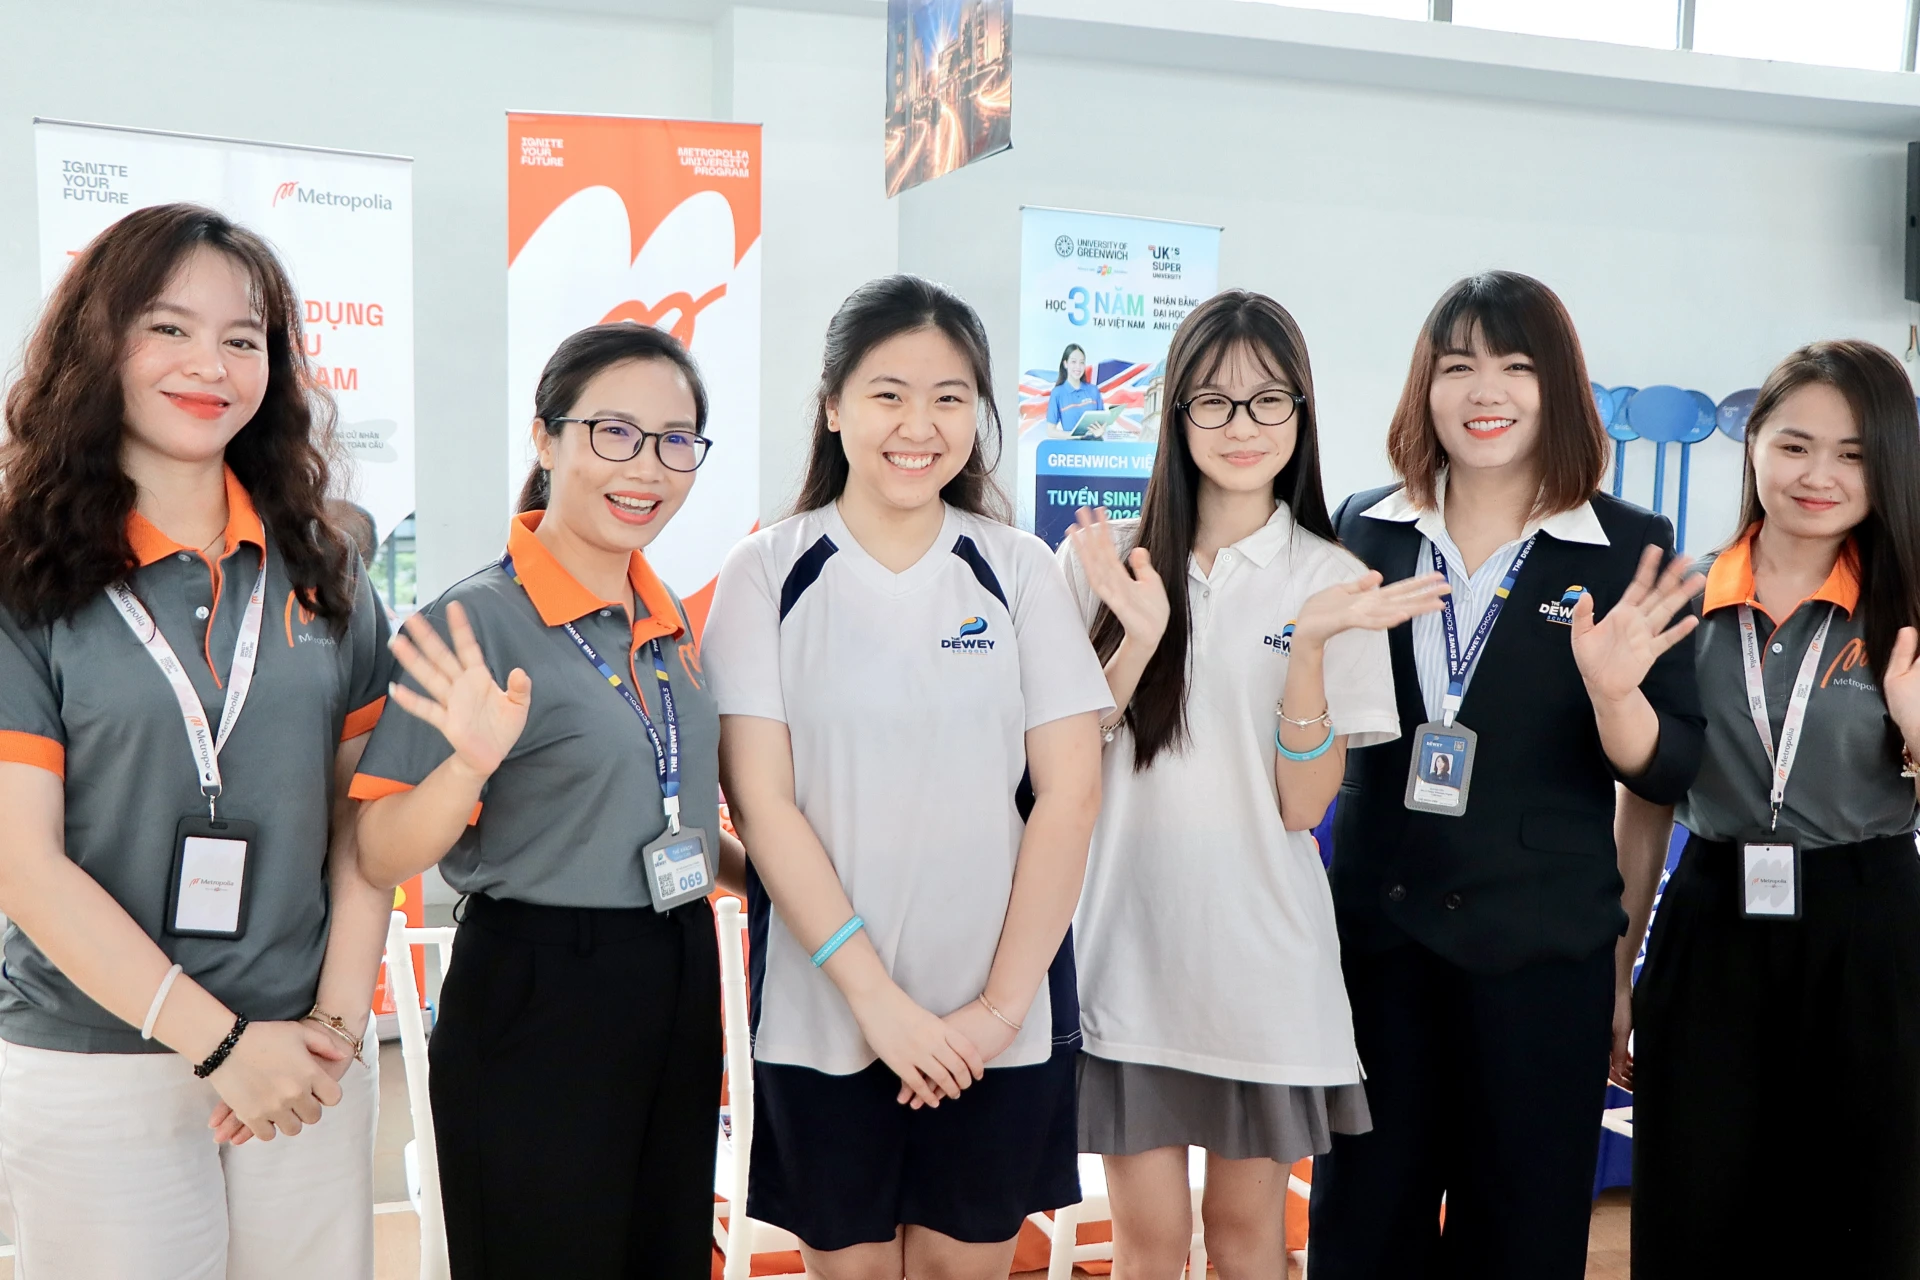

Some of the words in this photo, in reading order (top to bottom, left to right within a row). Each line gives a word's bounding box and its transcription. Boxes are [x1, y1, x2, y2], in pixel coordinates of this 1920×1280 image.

[521, 137, 563, 148] IGNITE
[522, 147, 551, 157] YOUR
[678, 147, 749, 159] METROPOLIA
[62, 160, 128, 177] IGNITE
[521, 156, 563, 167] FUTURE
[681, 157, 749, 169] UNIVERSITY
[694, 166, 749, 178] PROGRAM
[63, 174, 109, 189] YOUR
[63, 188, 129, 204] FUTURE
[298, 187, 392, 212] Metropolia
[1077, 239, 1117, 249] UNIVERSITY
[1119, 242, 1128, 250] OF
[1077, 247, 1128, 260] GREENWICH
[1153, 261, 1181, 272] SUPER
[1046, 300, 1067, 313] HỌC
[1067, 286, 1090, 326] 3
[1095, 286, 1144, 316] NĂM
[1153, 295, 1176, 307] NHẬN
[304, 300, 384, 331] DỤNG
[1169, 309, 1186, 320] HỌC
[1093, 317, 1106, 328] TẠI
[1108, 317, 1125, 329] VIỆT
[1127, 320, 1145, 330] NAM
[1153, 322, 1170, 330] ANH
[1048, 453, 1128, 469] GREENWICH
[1131, 453, 1155, 472] VIỆ
[1047, 486, 1099, 506] TUYỂN
[1103, 490, 1141, 507] SINH
[1512, 557, 1523, 572] THE
[1520, 535, 1537, 559] DEWEY
[1444, 600, 1454, 631] SCHOOLS
[1539, 603, 1574, 618] DEW
[1547, 615, 1573, 624] SCHOO
[564, 622, 585, 646] DEWE
[1458, 660, 1468, 676] THE
[1465, 635, 1482, 661] DEWEY
[1479, 602, 1499, 635] SCHOOLS
[583, 643, 597, 660] THE
[941, 639, 995, 650] DEWEY
[1263, 635, 1291, 653] DEW
[1449, 632, 1457, 660] DEWEY
[1746, 632, 1756, 669] Metropolia
[1833, 678, 1877, 691] Metropoli
[624, 690, 650, 726] SCHOOLS
[663, 687, 676, 722] SCHOOLS
[219, 691, 240, 738] Metropolia
[649, 727, 664, 759] DEWEY
[670, 723, 678, 756] DEWEY
[1780, 728, 1795, 767] Metropolia
[196, 729, 211, 769] Metropo
[659, 758, 667, 775] THE
[670, 756, 678, 773] THE
[200, 878, 235, 887] Metropolia
[679, 870, 703, 890] 069
